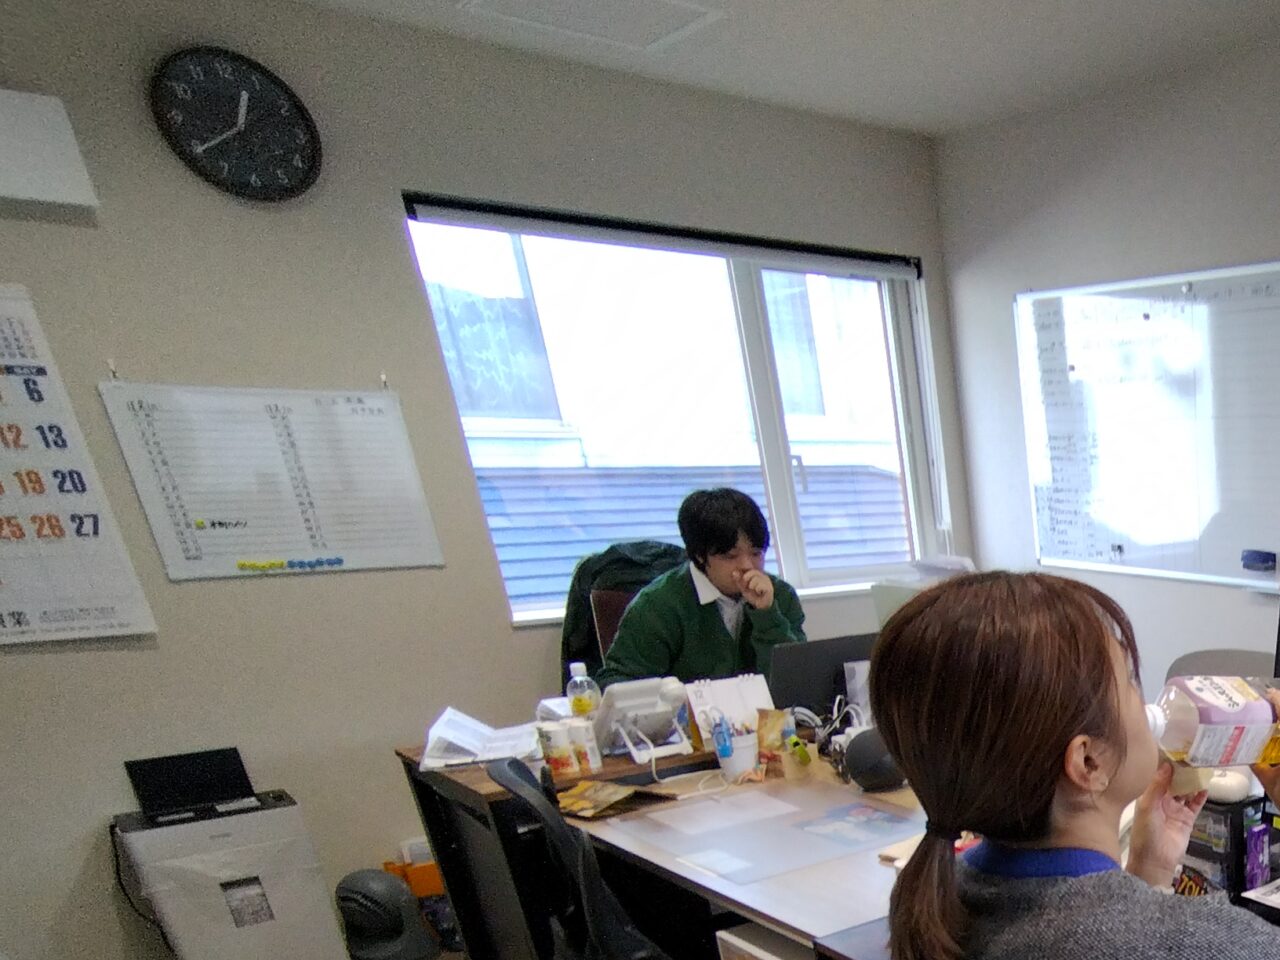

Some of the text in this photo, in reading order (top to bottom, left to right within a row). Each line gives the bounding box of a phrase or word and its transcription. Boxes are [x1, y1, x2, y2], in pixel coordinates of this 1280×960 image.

[23, 377, 45, 403] 6
[35, 423, 68, 449] 13
[13, 468, 87, 496] 19 20
[30, 513, 66, 539] 26
[70, 513, 99, 538] 27
